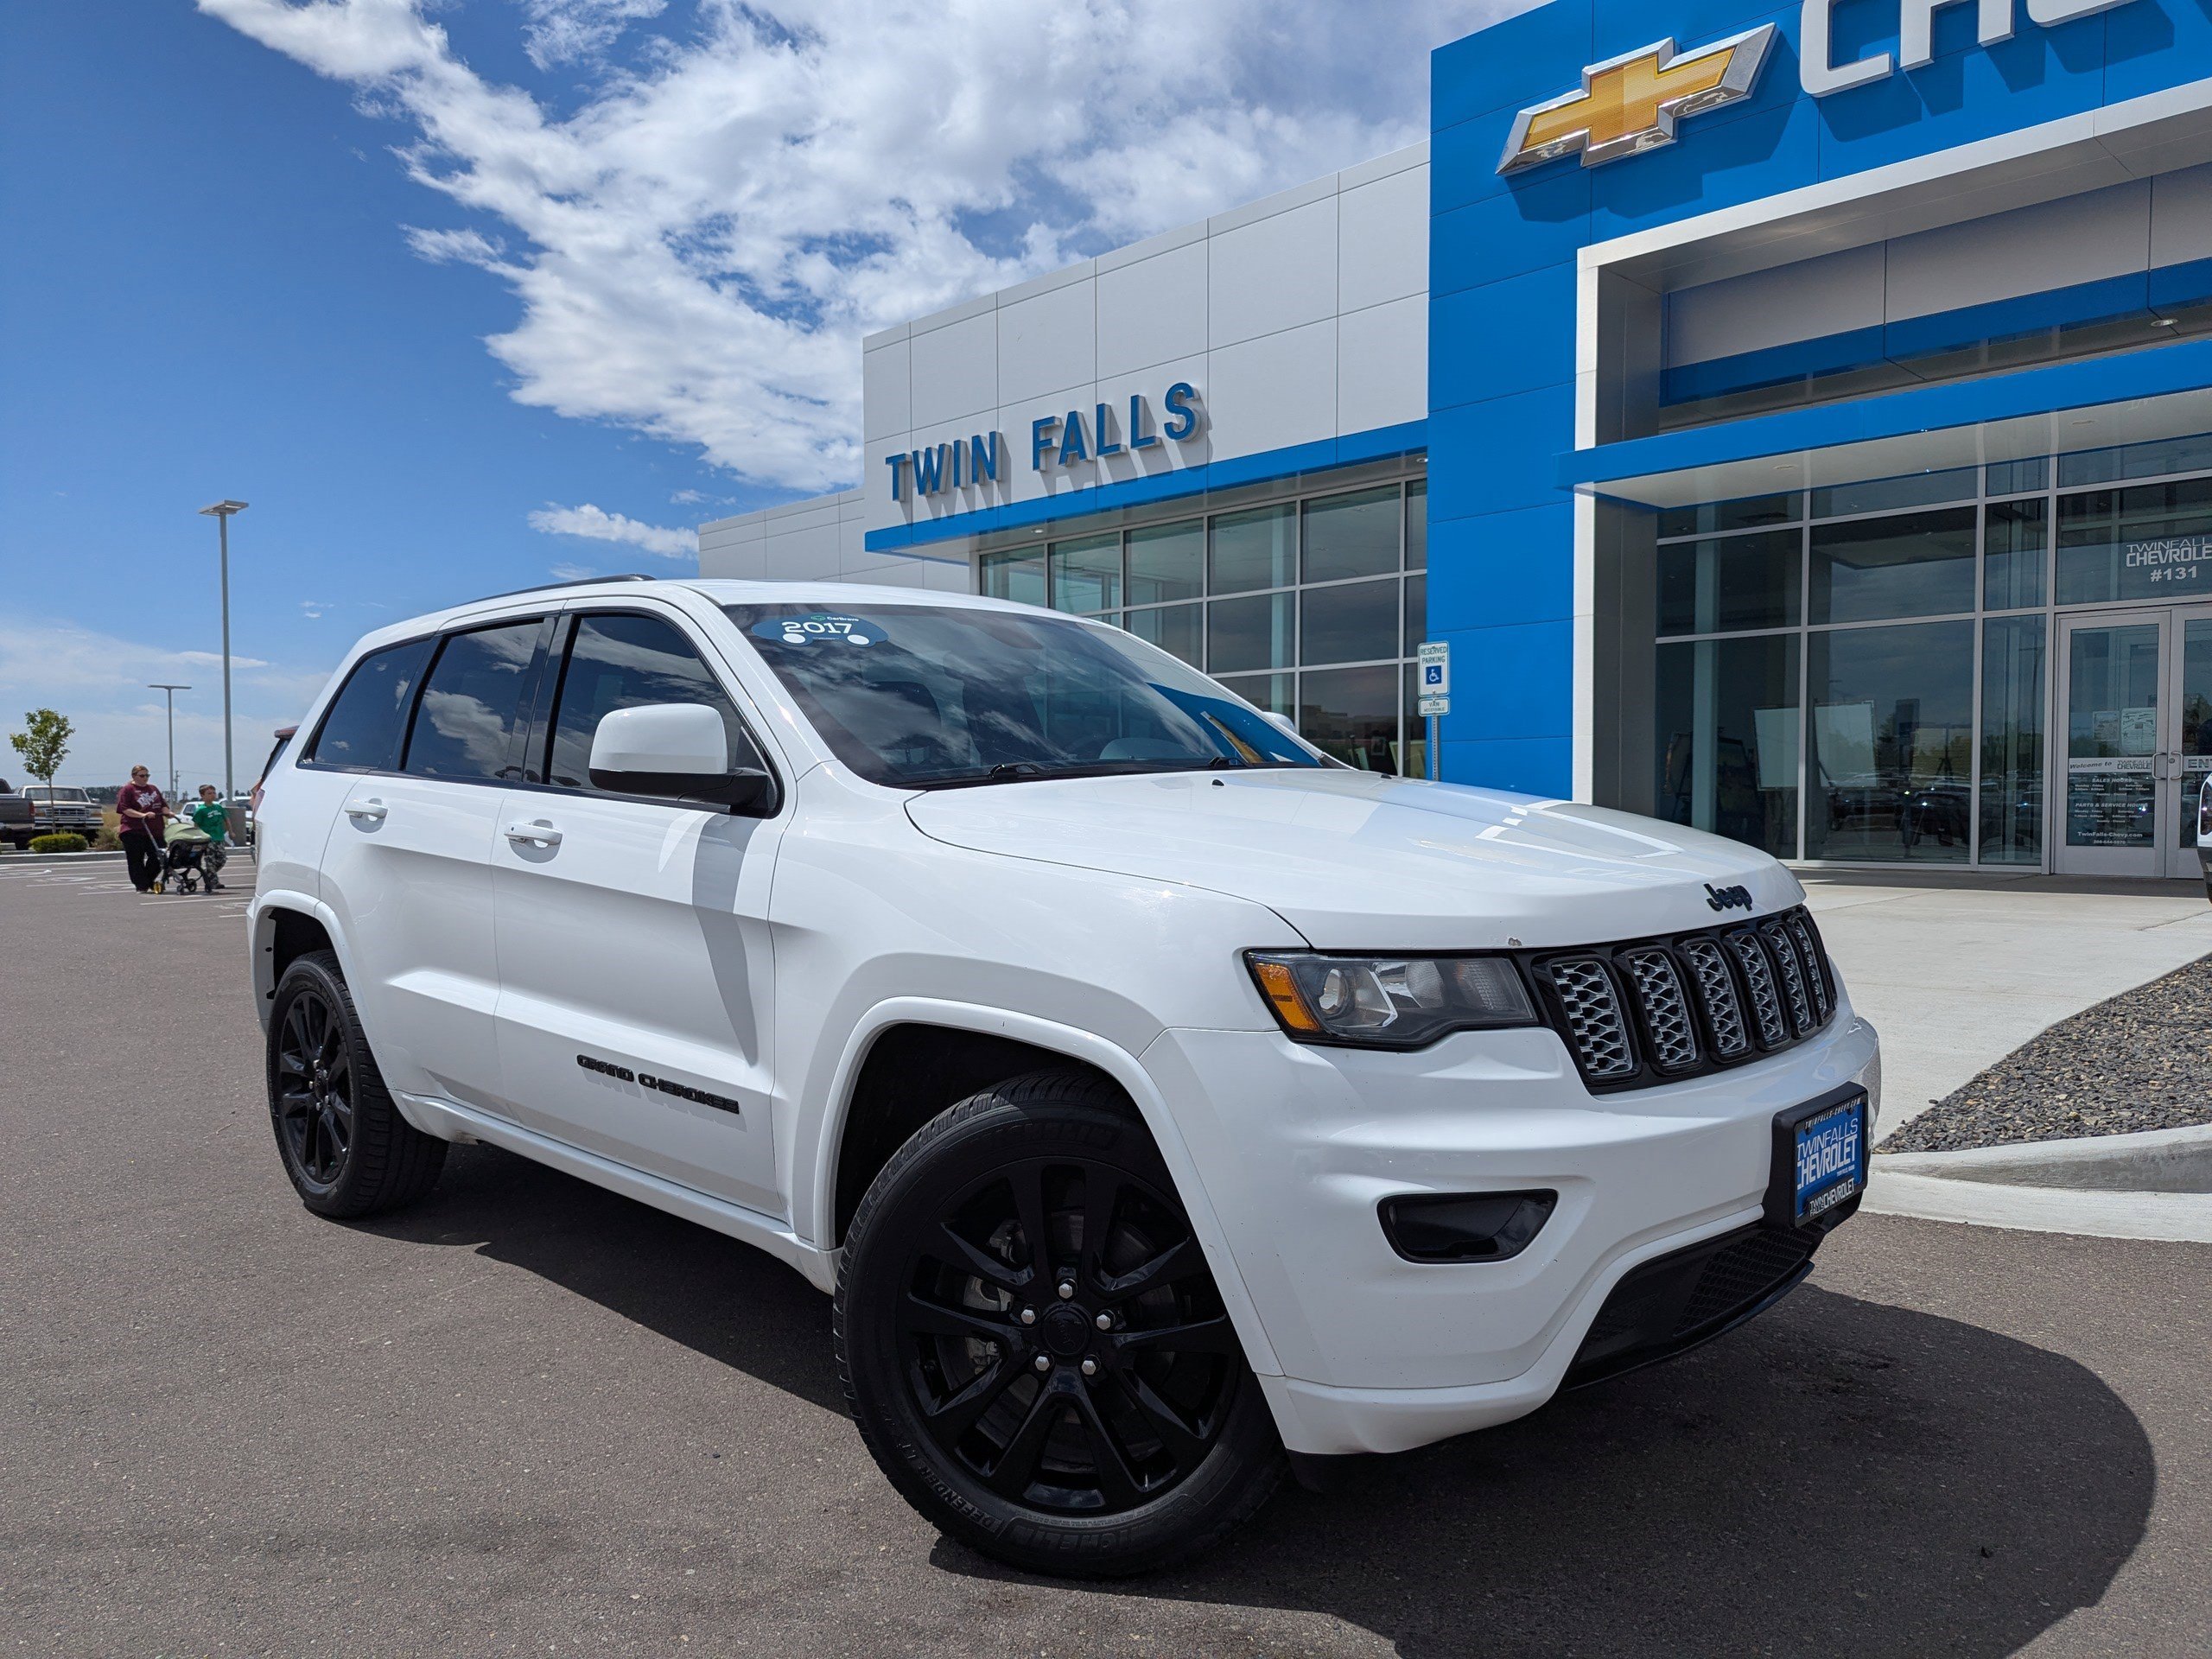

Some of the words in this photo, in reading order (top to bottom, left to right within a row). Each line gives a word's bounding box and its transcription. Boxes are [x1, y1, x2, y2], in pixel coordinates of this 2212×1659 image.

[885, 430, 1003, 501] TWIN
[1032, 382, 1204, 472] FALLS
[2150, 566, 2197, 582] #131
[781, 621, 853, 634] 2017
[1420, 645, 1447, 655] RESERVED
[1421, 656, 1446, 664] PARKING
[2188, 759, 2212, 768] EN
[1703, 883, 1752, 912] Jeep
[576, 1054, 634, 1082] GRAND
[638, 1072, 740, 1115] CHEROKEE
[1796, 1117, 1859, 1161] TWINFALLS
[1823, 1177, 1855, 1209] CHEVROLET
